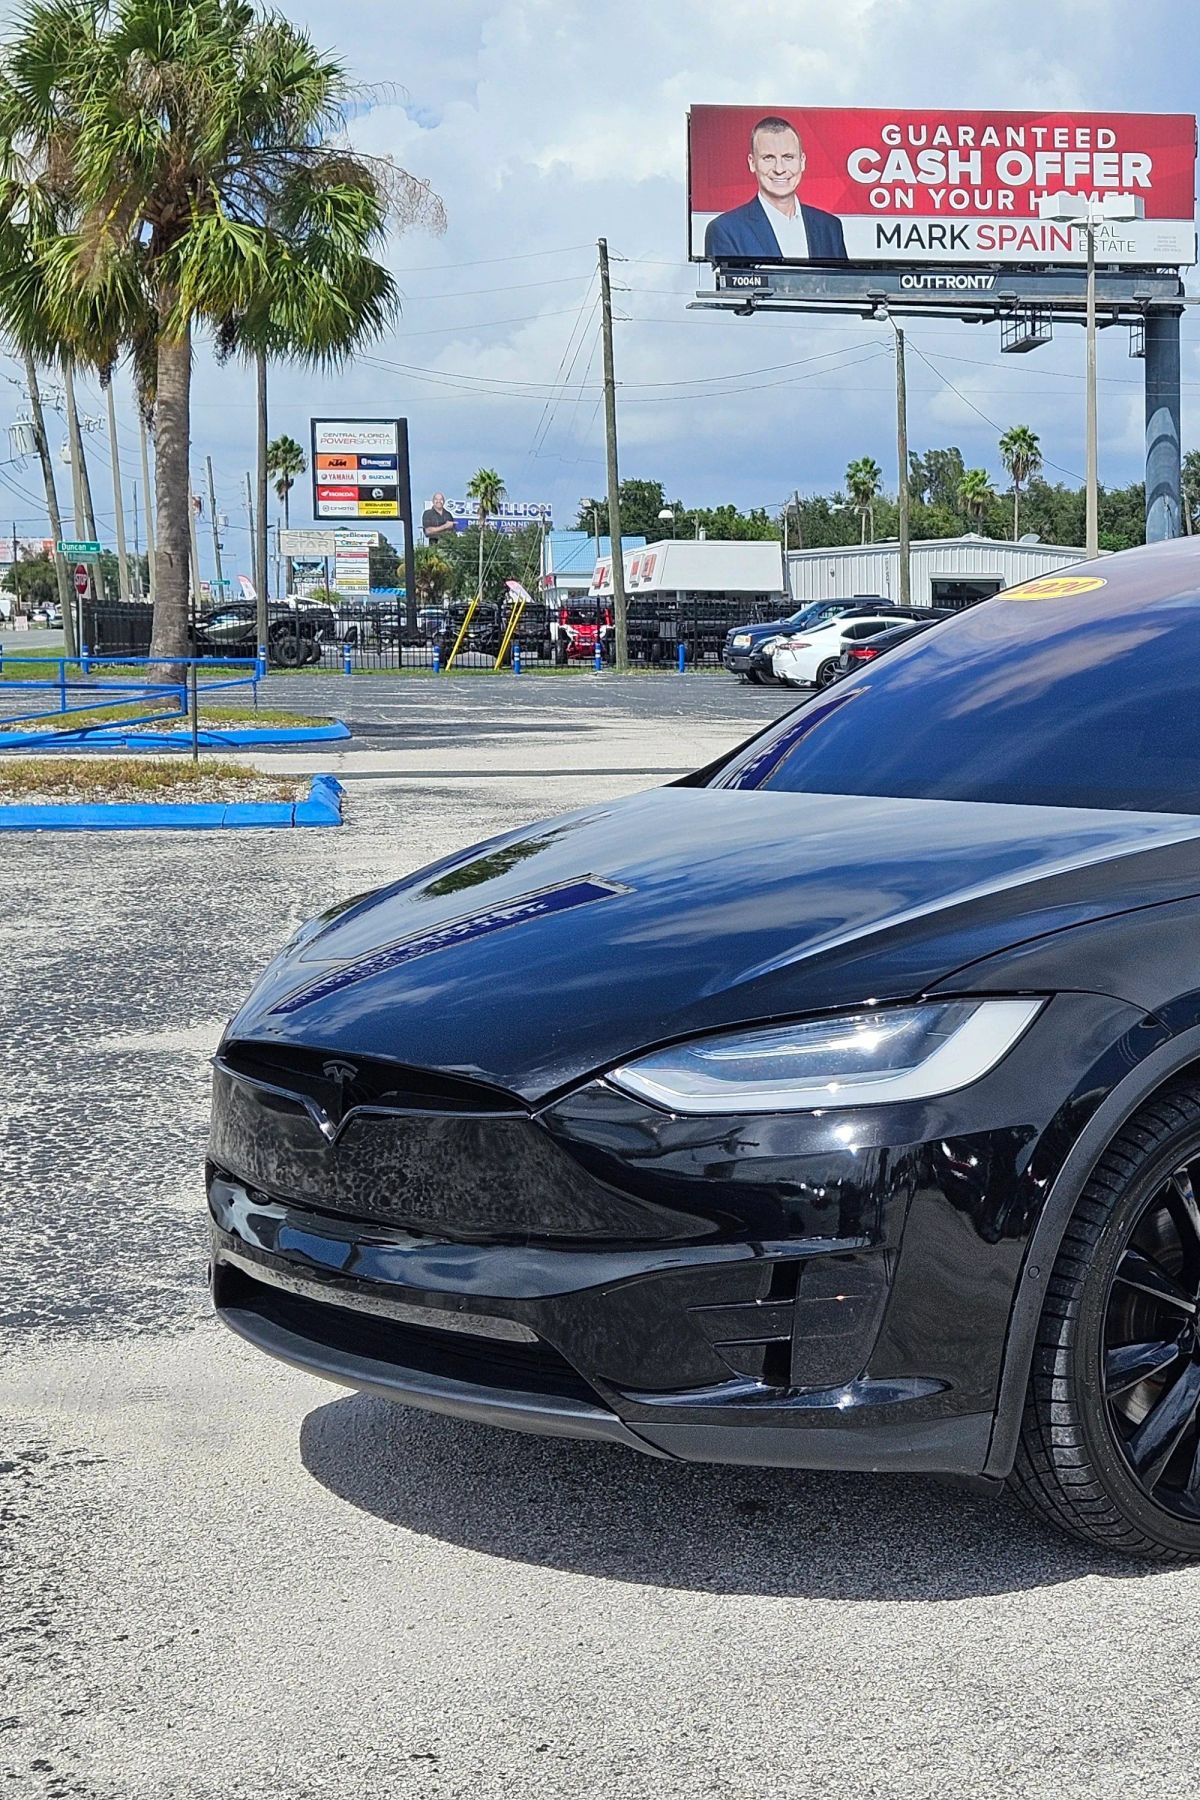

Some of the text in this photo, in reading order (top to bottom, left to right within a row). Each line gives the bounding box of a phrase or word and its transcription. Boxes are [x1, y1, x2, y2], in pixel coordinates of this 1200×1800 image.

[881, 124, 1116, 149] GUARANTEED
[847, 147, 1152, 187] CASH OFFER
[869, 187, 914, 209] ON
[927, 188, 1015, 211] YOUR
[876, 223, 1072, 251] MARK SPAIN
[732, 276, 761, 286] 7004N
[328, 459, 348, 467] KTM
[61, 543, 87, 551] Duncan
